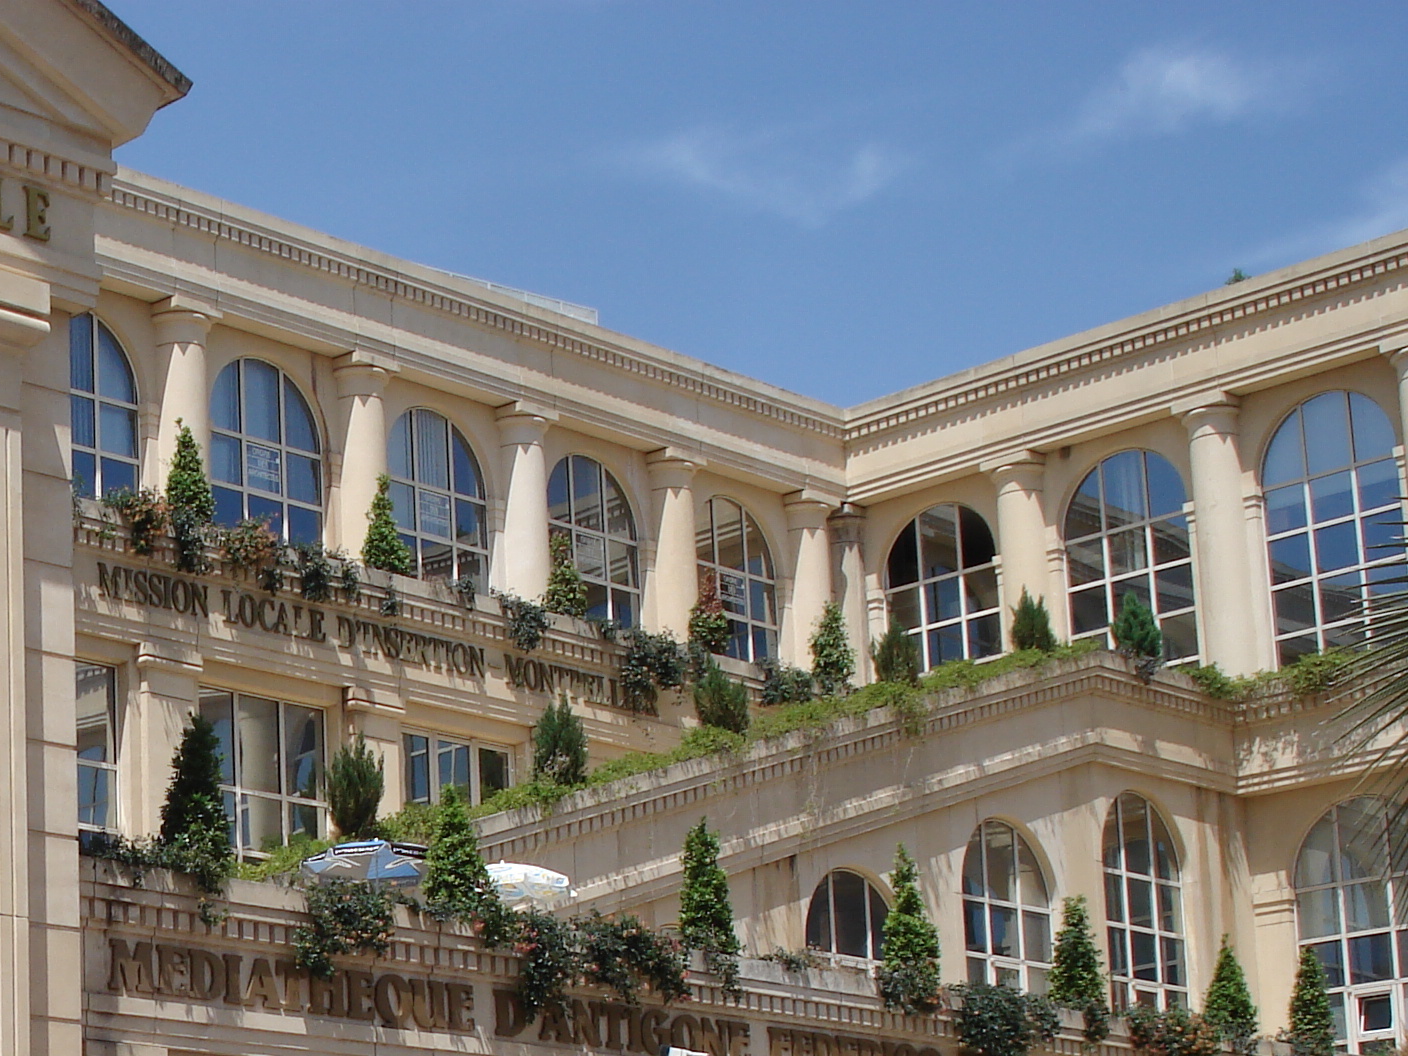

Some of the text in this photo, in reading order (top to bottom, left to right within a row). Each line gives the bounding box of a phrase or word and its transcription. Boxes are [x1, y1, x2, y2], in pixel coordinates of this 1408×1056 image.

[96, 561, 210, 619] MISSION
[220, 588, 328, 643] LOCALE
[336, 614, 486, 679] D'INSERTION
[107, 937, 475, 1032] MEDIATHEQUE
